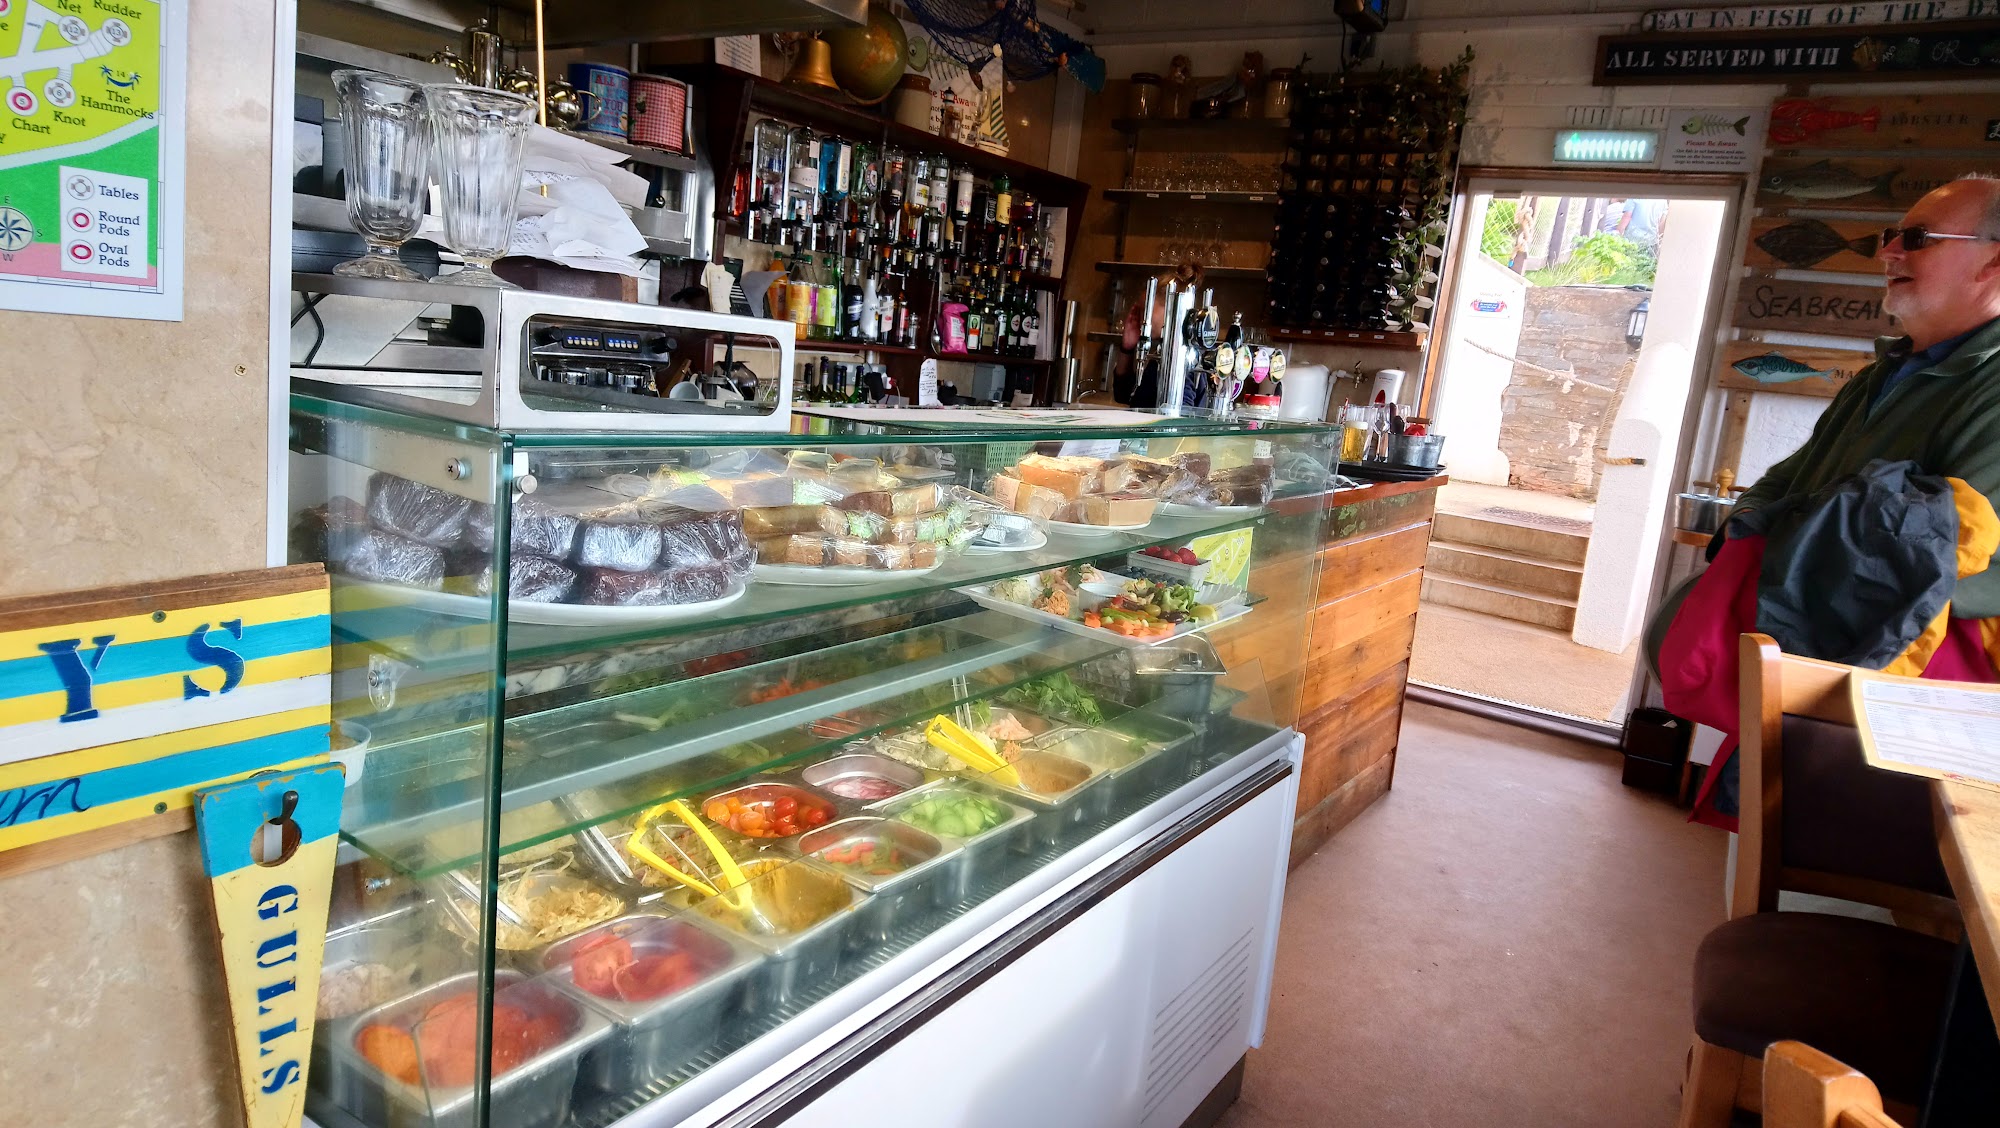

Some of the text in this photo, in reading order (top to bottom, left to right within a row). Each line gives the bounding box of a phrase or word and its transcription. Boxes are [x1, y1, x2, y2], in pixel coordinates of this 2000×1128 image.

[57, 0, 82, 14] Net
[93, 0, 142, 20] Rudder
[1650, 10, 1699, 30] EAT
[1709, 10, 1736, 28] IN
[1749, 7, 1814, 27] FISH
[1827, 6, 1866, 25] OF
[1884, 1, 1947, 22] THE
[1607, 46, 1841, 69] ALL SERVED WITH
[106, 89, 130, 104] The
[81, 95, 154, 120] Hammocks
[12, 117, 51, 135] Chart
[53, 110, 86, 127] Knot
[98, 184, 140, 201] Tables
[98, 210, 140, 226] Round
[98, 223, 130, 237] Pods
[98, 242, 128, 256] Oval
[98, 255, 130, 268] Pods
[256, 884, 301, 1095] GULLS
